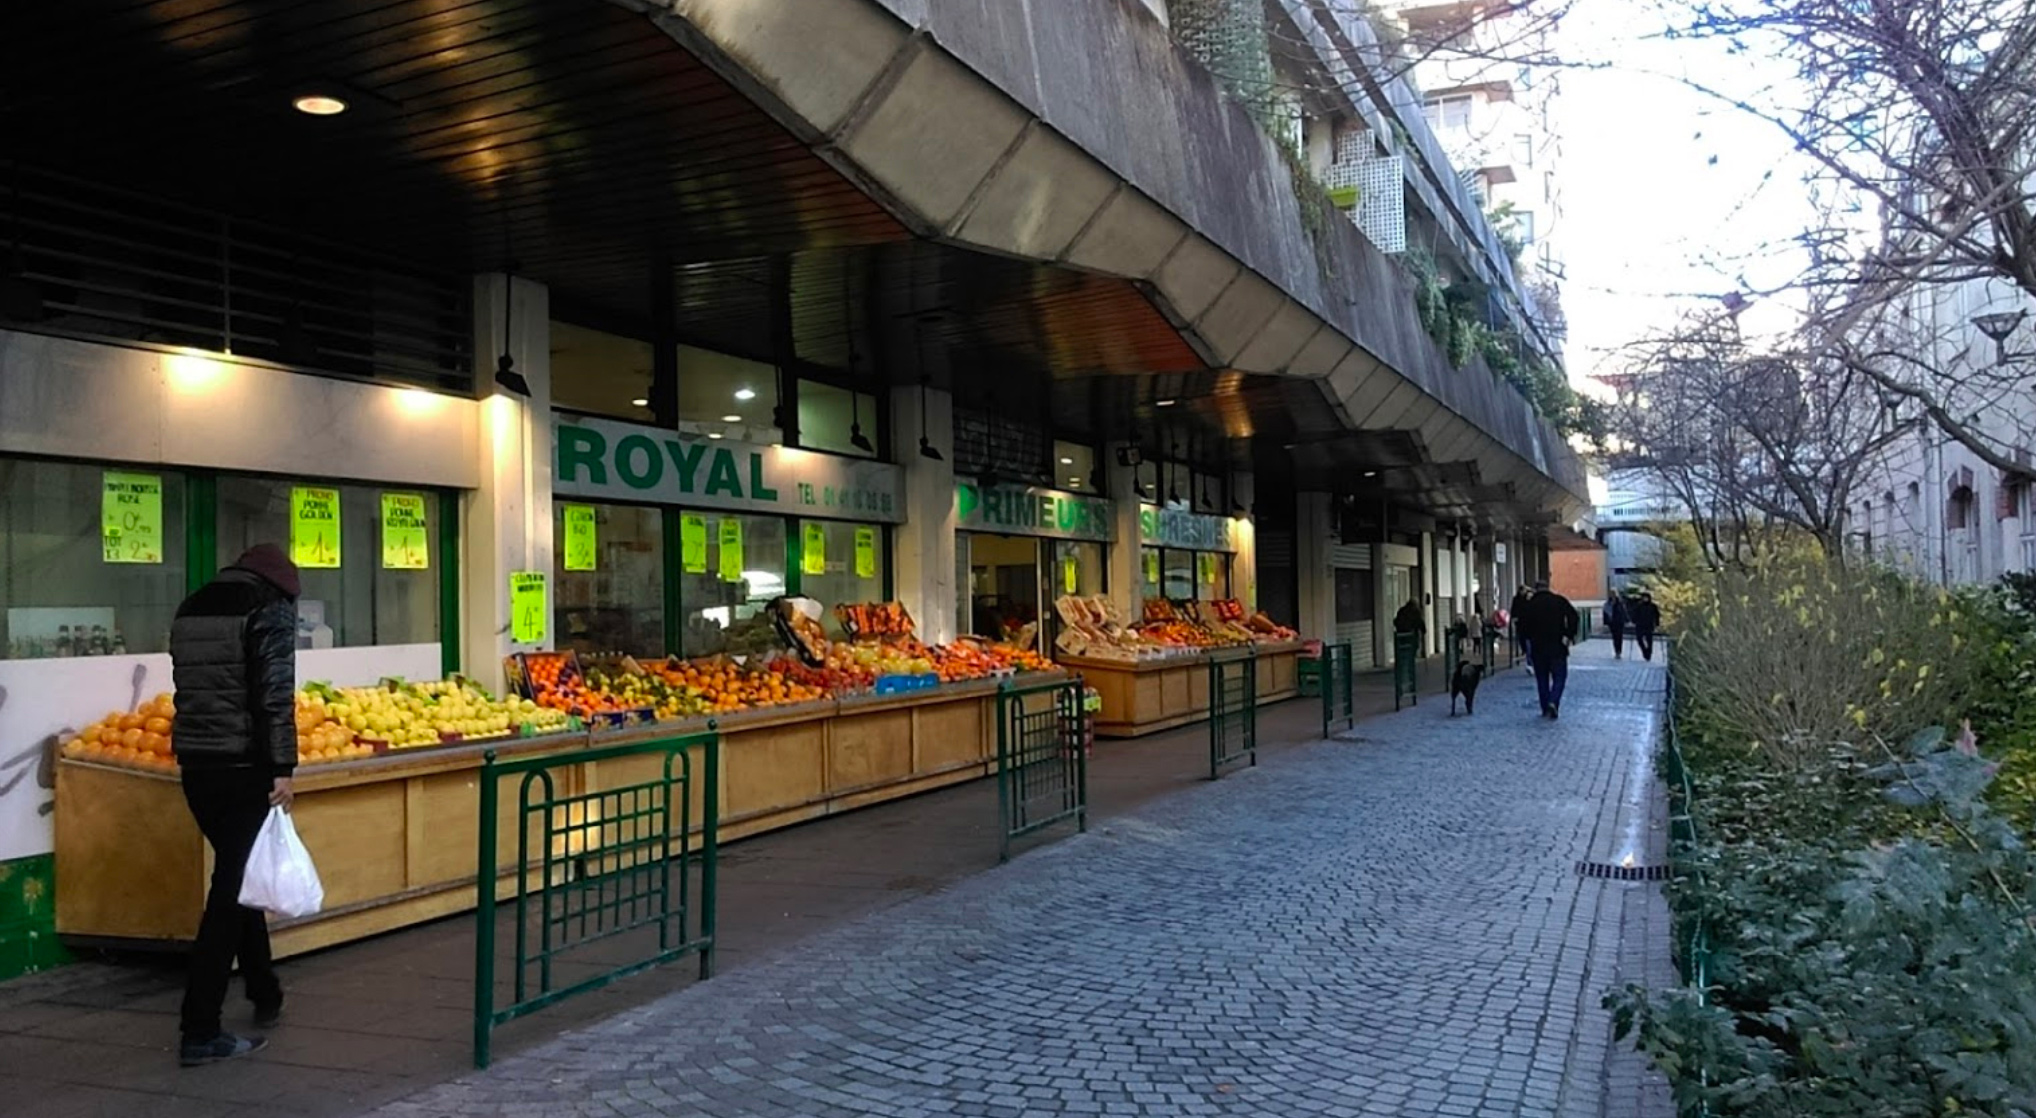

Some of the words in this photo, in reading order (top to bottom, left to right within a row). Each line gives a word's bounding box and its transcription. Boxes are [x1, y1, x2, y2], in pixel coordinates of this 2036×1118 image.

[557, 424, 778, 501] ROYAL
[798, 482, 816, 505] TEL
[958, 482, 1109, 537] PRIMEURS
